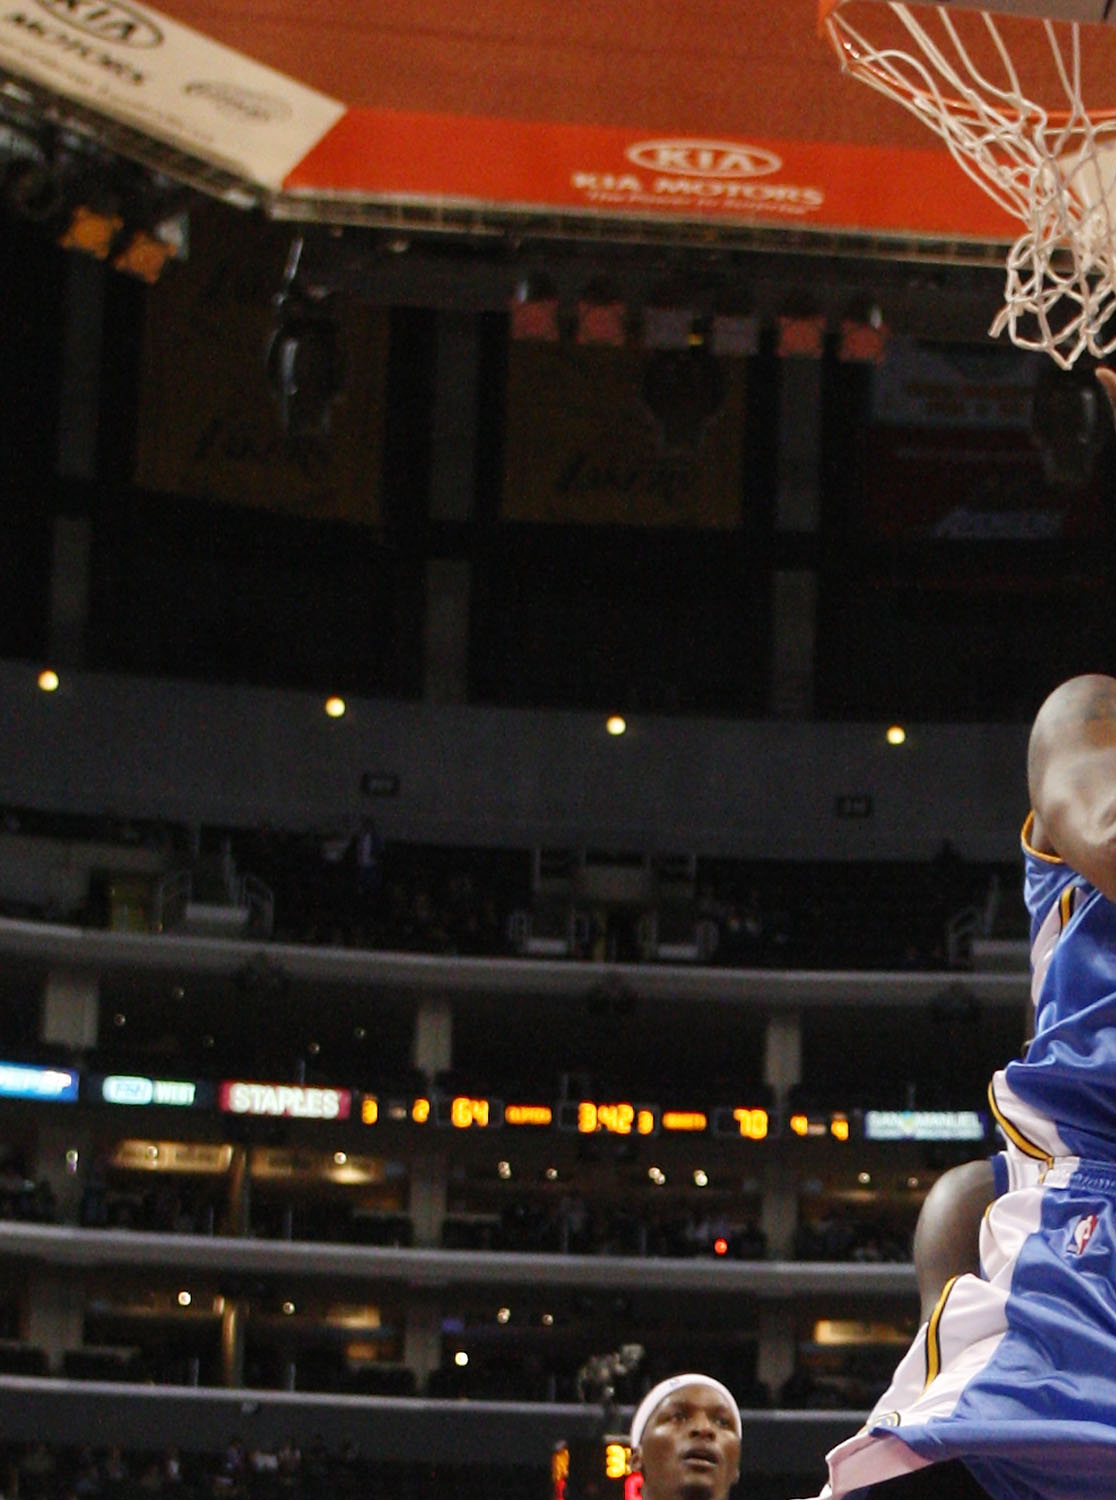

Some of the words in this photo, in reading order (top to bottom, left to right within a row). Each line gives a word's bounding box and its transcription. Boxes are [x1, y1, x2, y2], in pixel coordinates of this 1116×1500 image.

[656, 148, 753, 172] KIA
[572, 171, 642, 192] KIA
[655, 177, 824, 206] MOTORS
[229, 1083, 341, 1119] STAPLES
